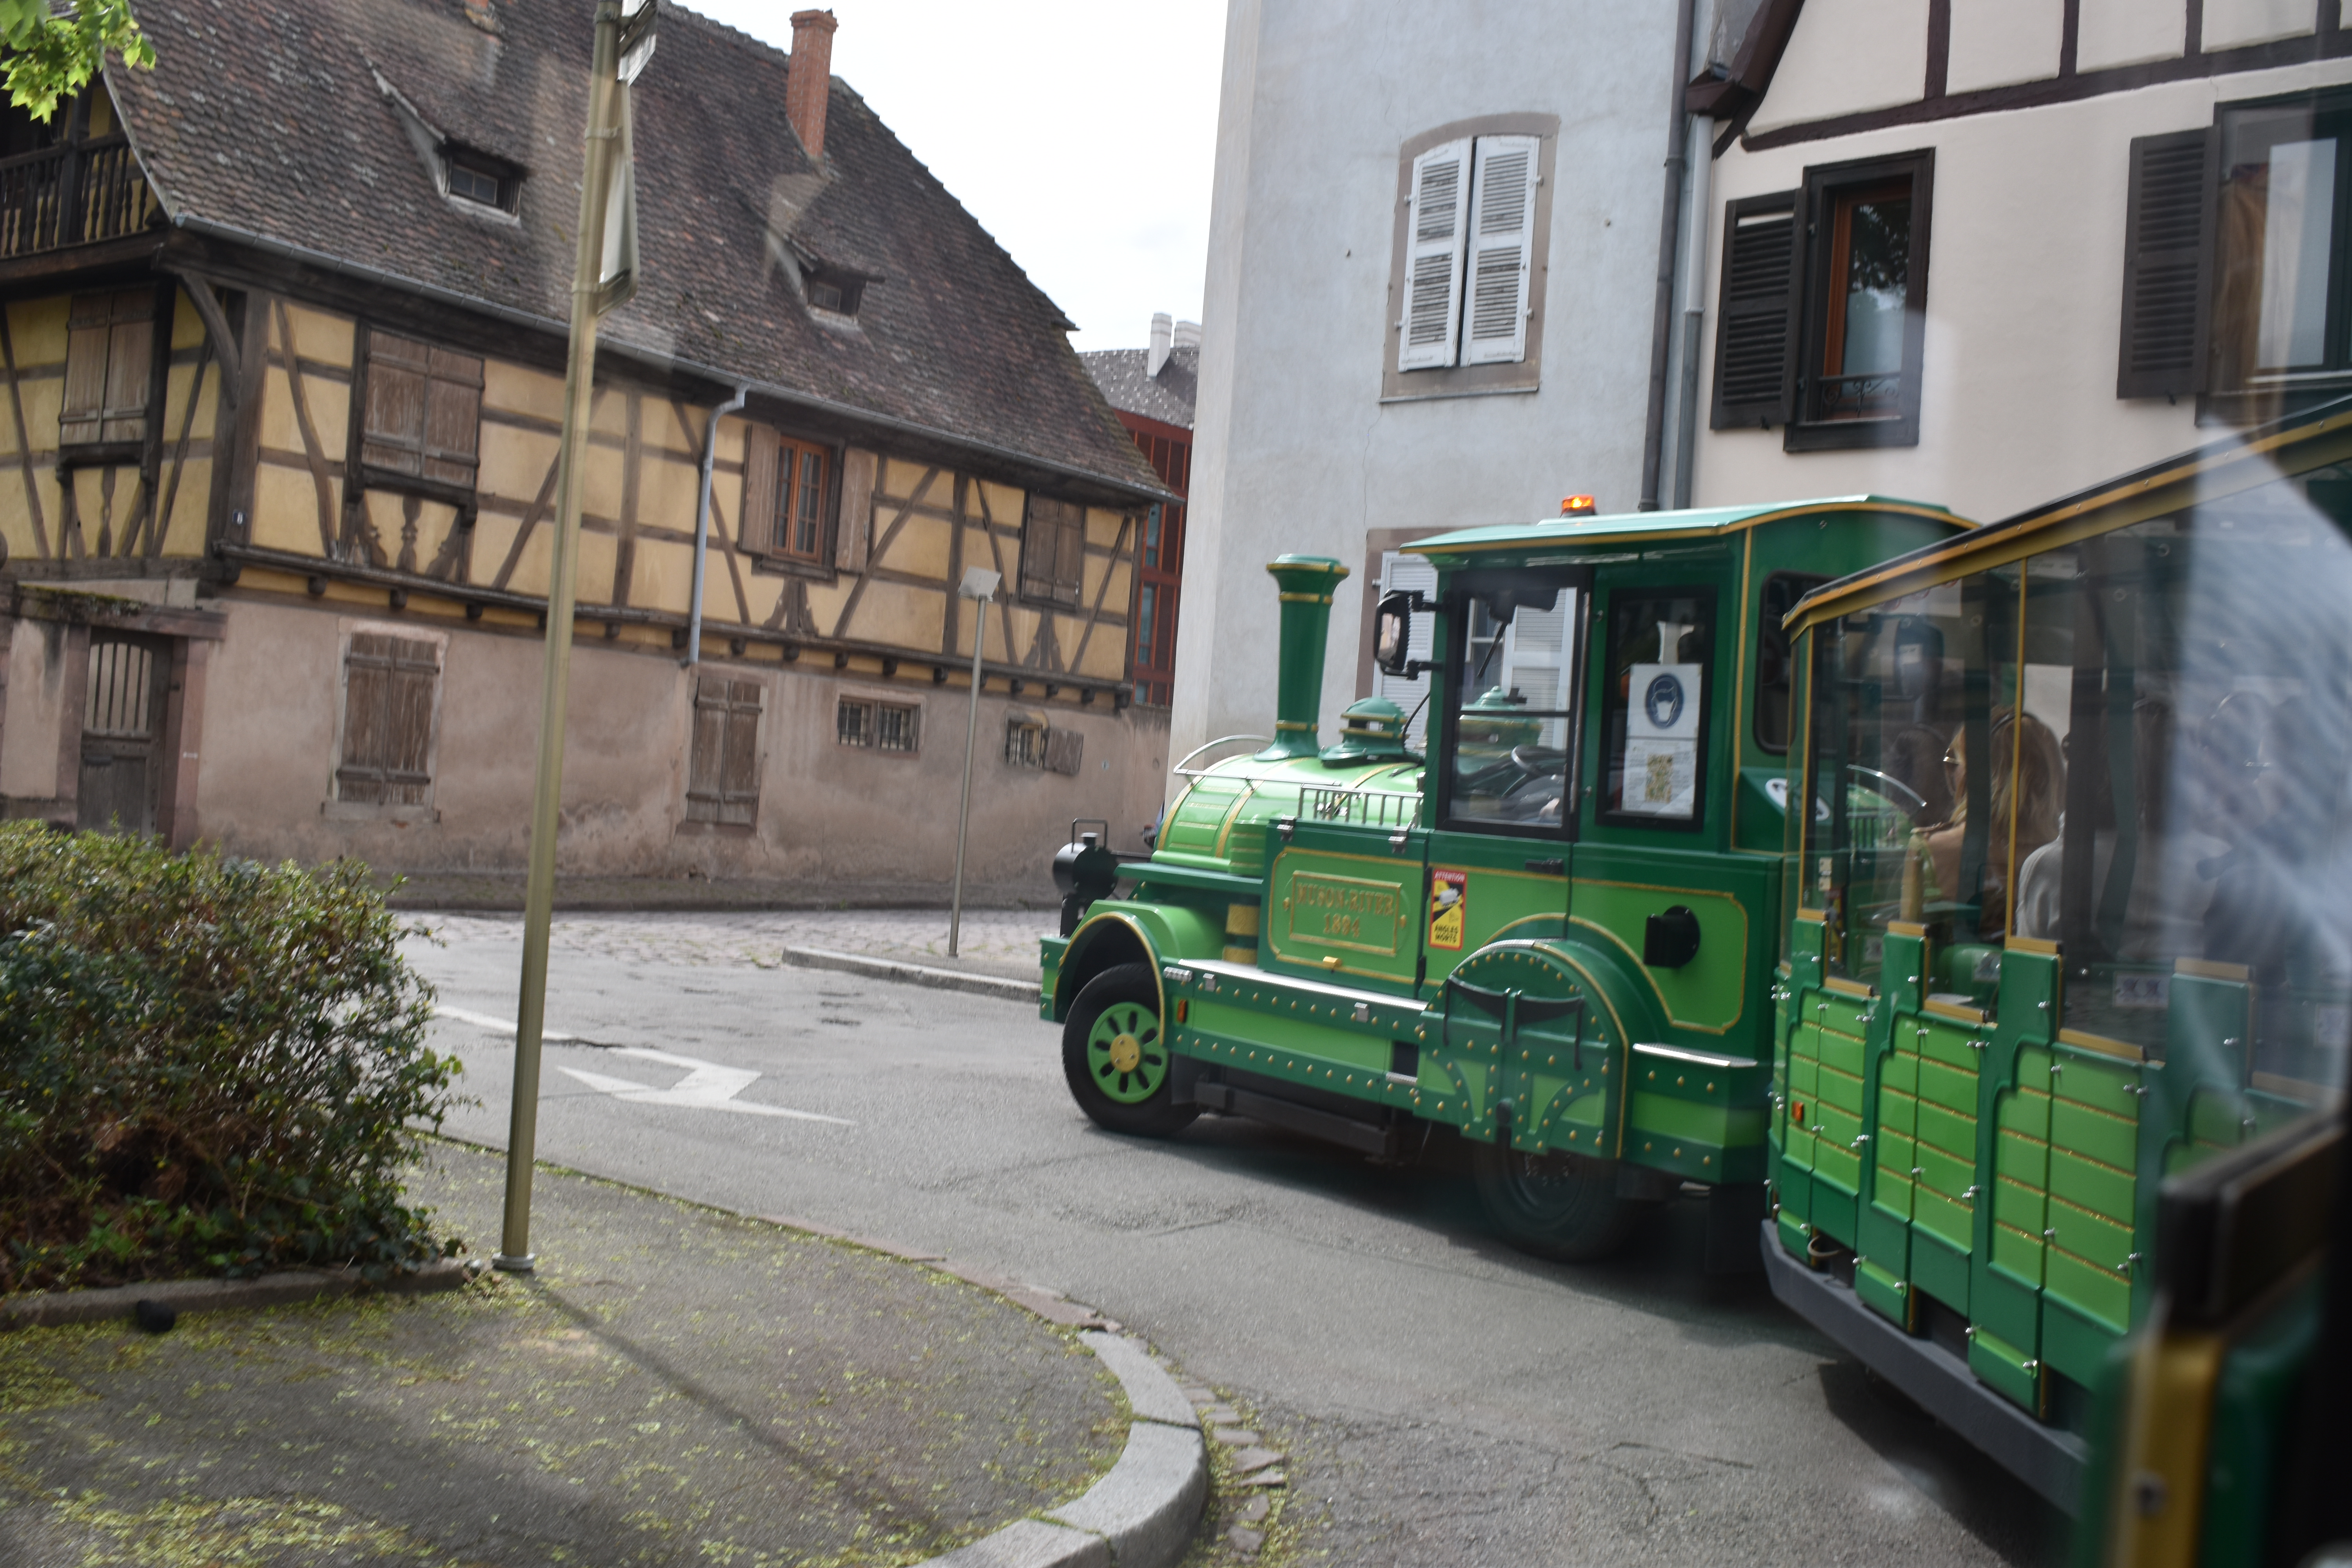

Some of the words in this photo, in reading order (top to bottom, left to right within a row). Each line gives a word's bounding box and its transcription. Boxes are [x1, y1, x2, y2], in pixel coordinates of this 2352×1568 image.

[1434, 871, 1465, 882] ATTENTION
[1434, 924, 1458, 934] ANGLES
[1435, 933, 1457, 944] MORTS
